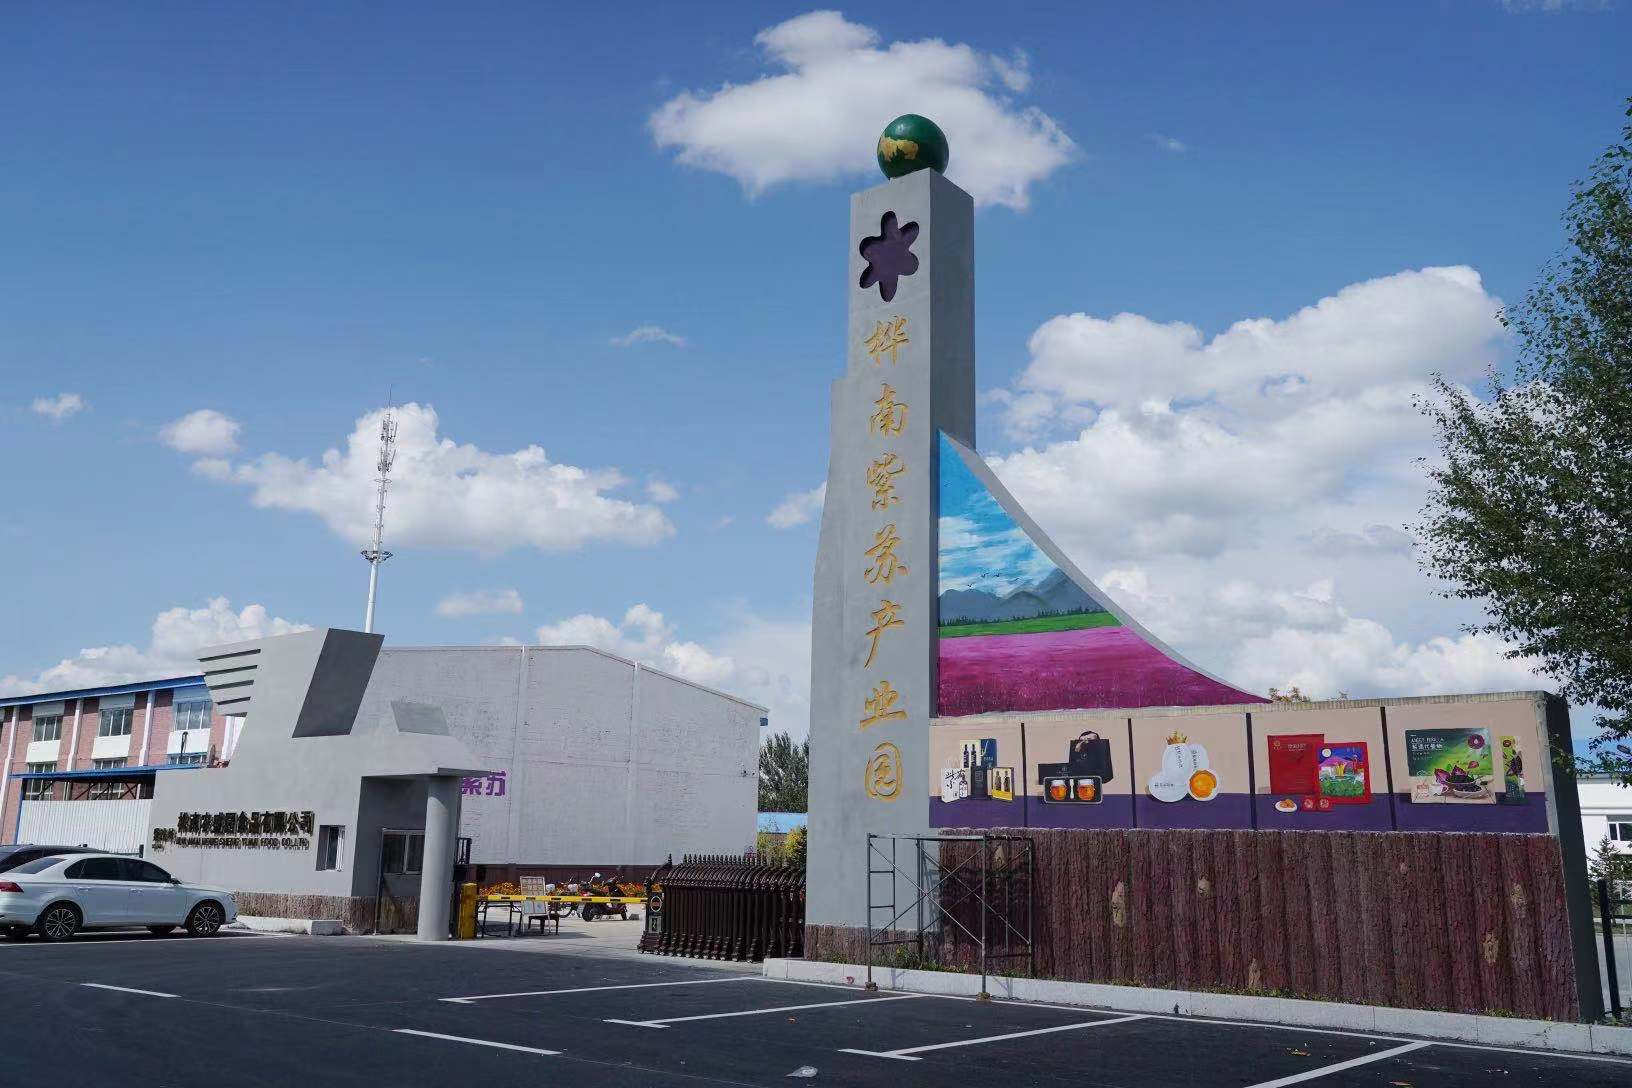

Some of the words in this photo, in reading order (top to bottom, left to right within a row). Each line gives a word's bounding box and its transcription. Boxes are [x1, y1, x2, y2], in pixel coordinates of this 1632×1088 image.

[860, 313, 910, 801] 桦南紫苏产业园
